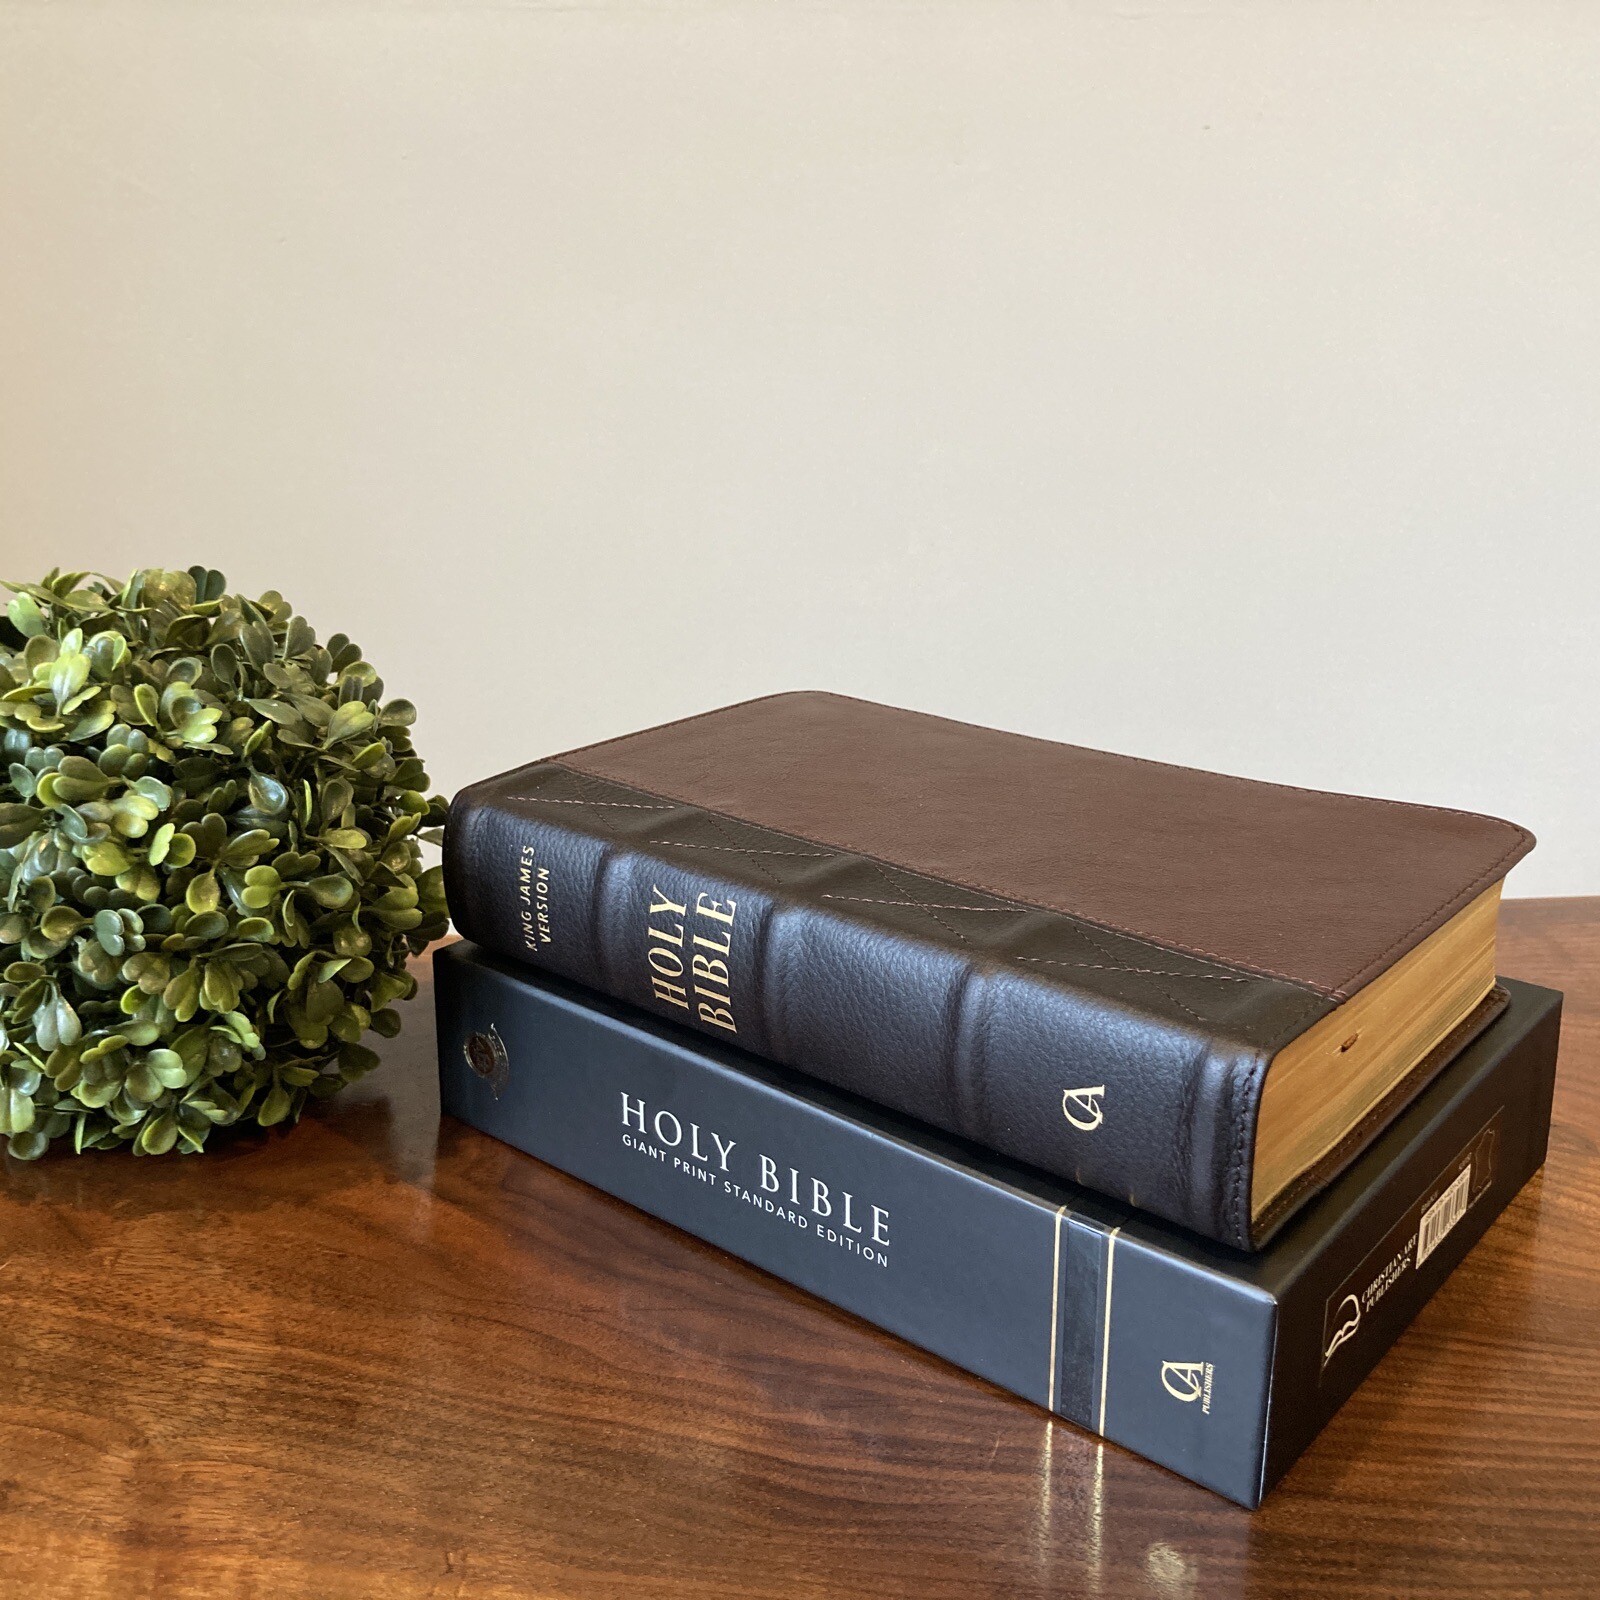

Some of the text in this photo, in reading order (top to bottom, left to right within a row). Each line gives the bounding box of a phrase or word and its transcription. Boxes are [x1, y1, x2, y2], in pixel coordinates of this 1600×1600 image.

[519, 845, 538, 952] KING JAMES
[535, 868, 552, 944] VERSION
[647, 883, 690, 1010] HOLY
[692, 892, 738, 1034] BIBLE
[620, 1091, 890, 1246] HOLY BIBLE
[622, 1134, 889, 1268] GIANT PRINT STANDARD EDITION
[1361, 1232, 1418, 1304] CHRISTIAN ART
[1366, 1257, 1411, 1313] PUBLISHERS
